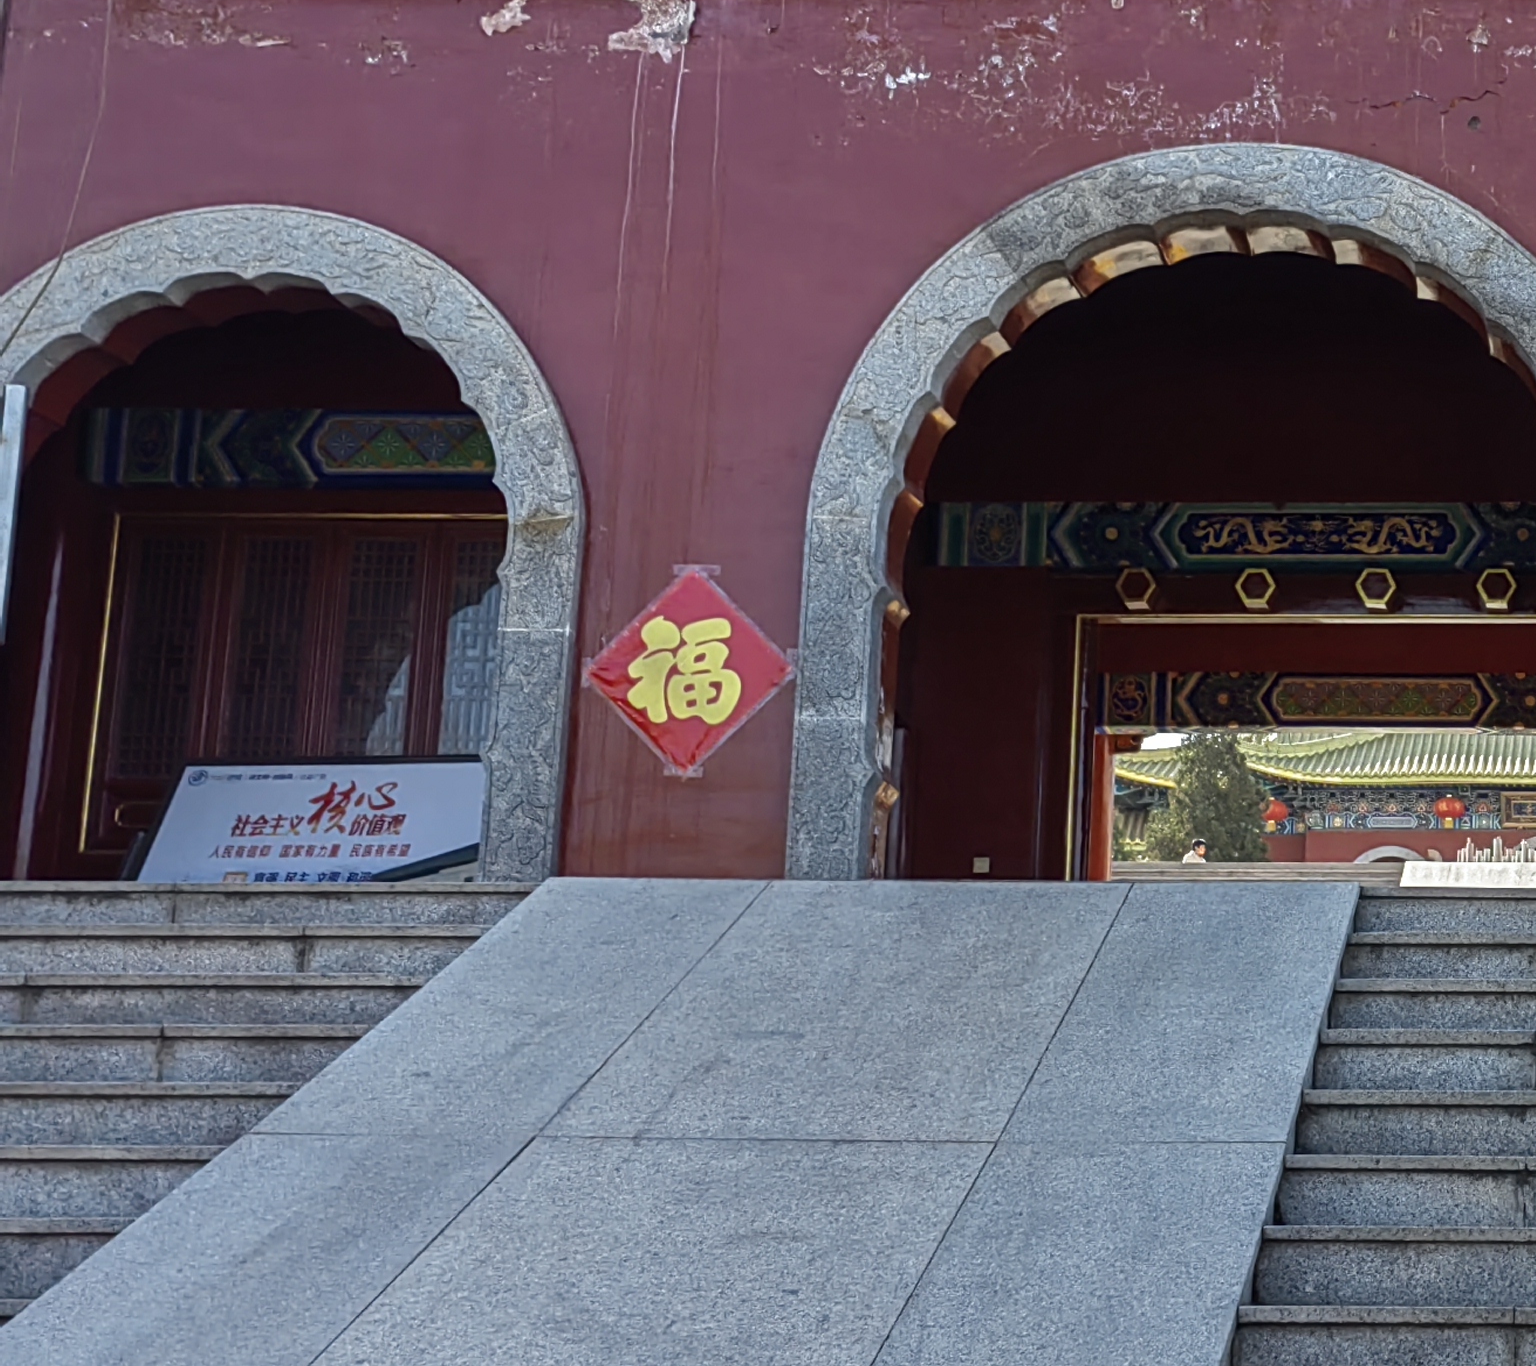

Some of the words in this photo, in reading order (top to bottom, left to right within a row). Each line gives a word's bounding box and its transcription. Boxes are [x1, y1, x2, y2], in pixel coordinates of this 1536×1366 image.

[627, 615, 742, 725] 福
[231, 814, 305, 837] 社会主义
[307, 780, 399, 834] 核心
[348, 814, 407, 837] 价值观
